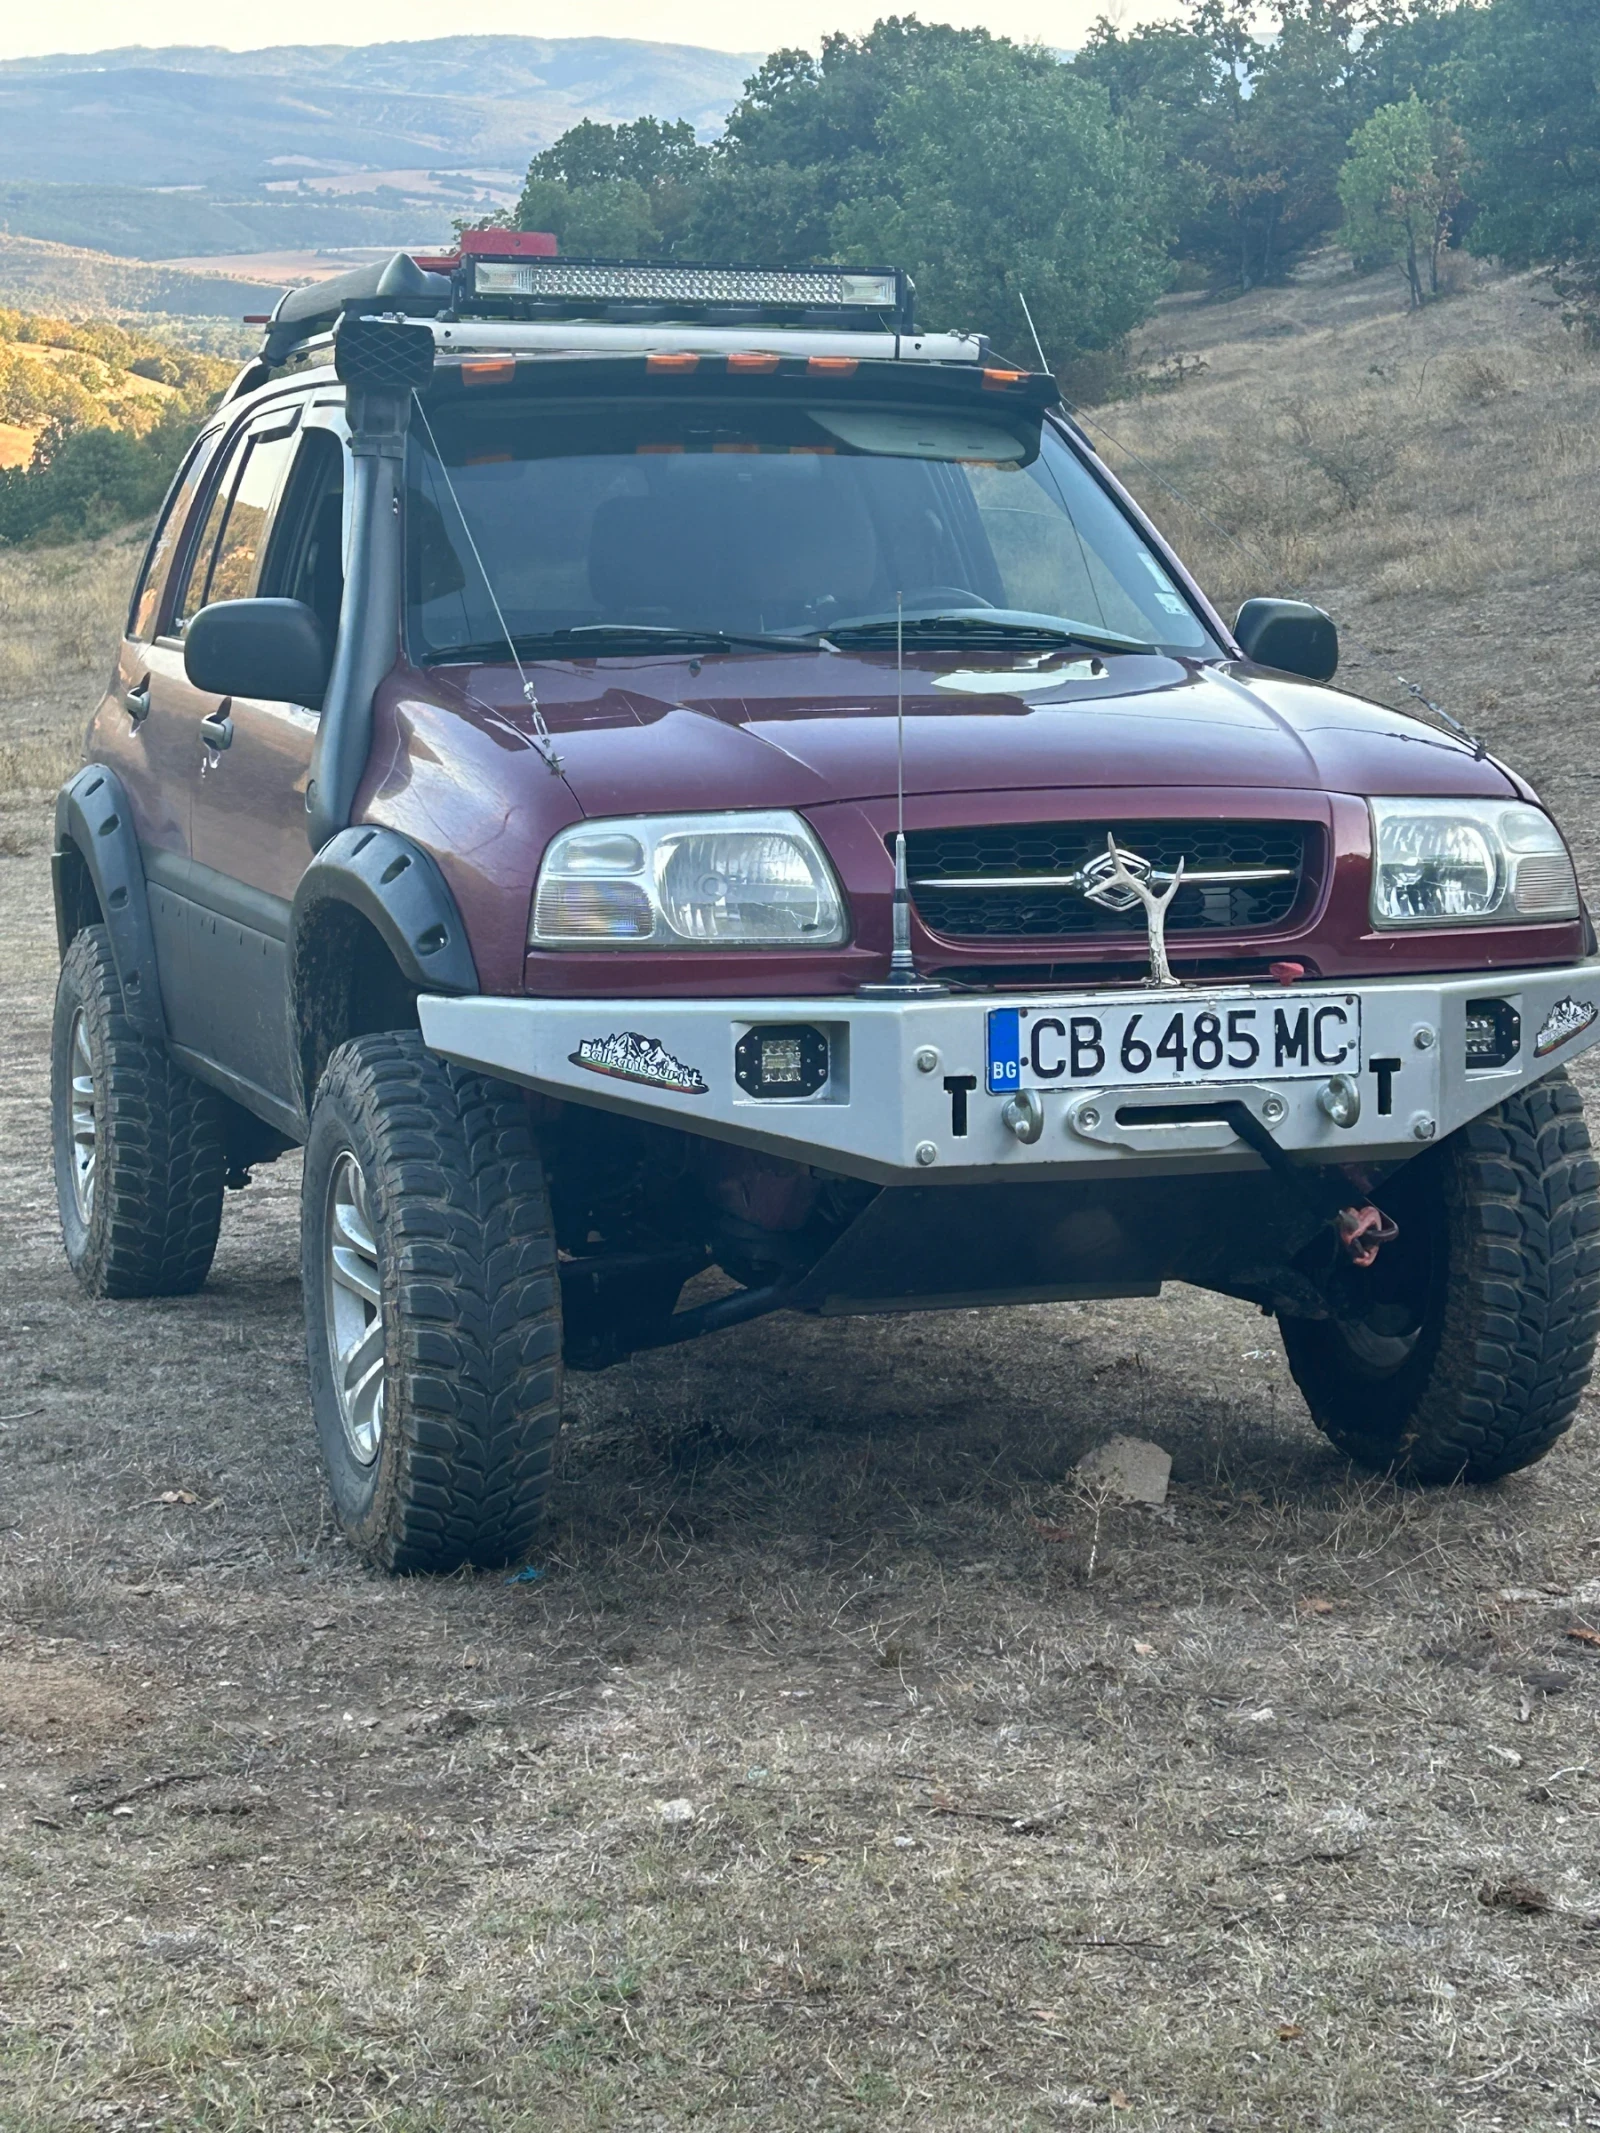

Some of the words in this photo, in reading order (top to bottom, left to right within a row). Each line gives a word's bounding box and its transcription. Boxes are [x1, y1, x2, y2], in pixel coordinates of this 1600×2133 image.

[1031, 1016, 1105, 1078] CB
[1121, 1009, 1260, 1074] 6485
[1274, 1005, 1348, 1067] MC
[993, 1061, 1017, 1080] BG
